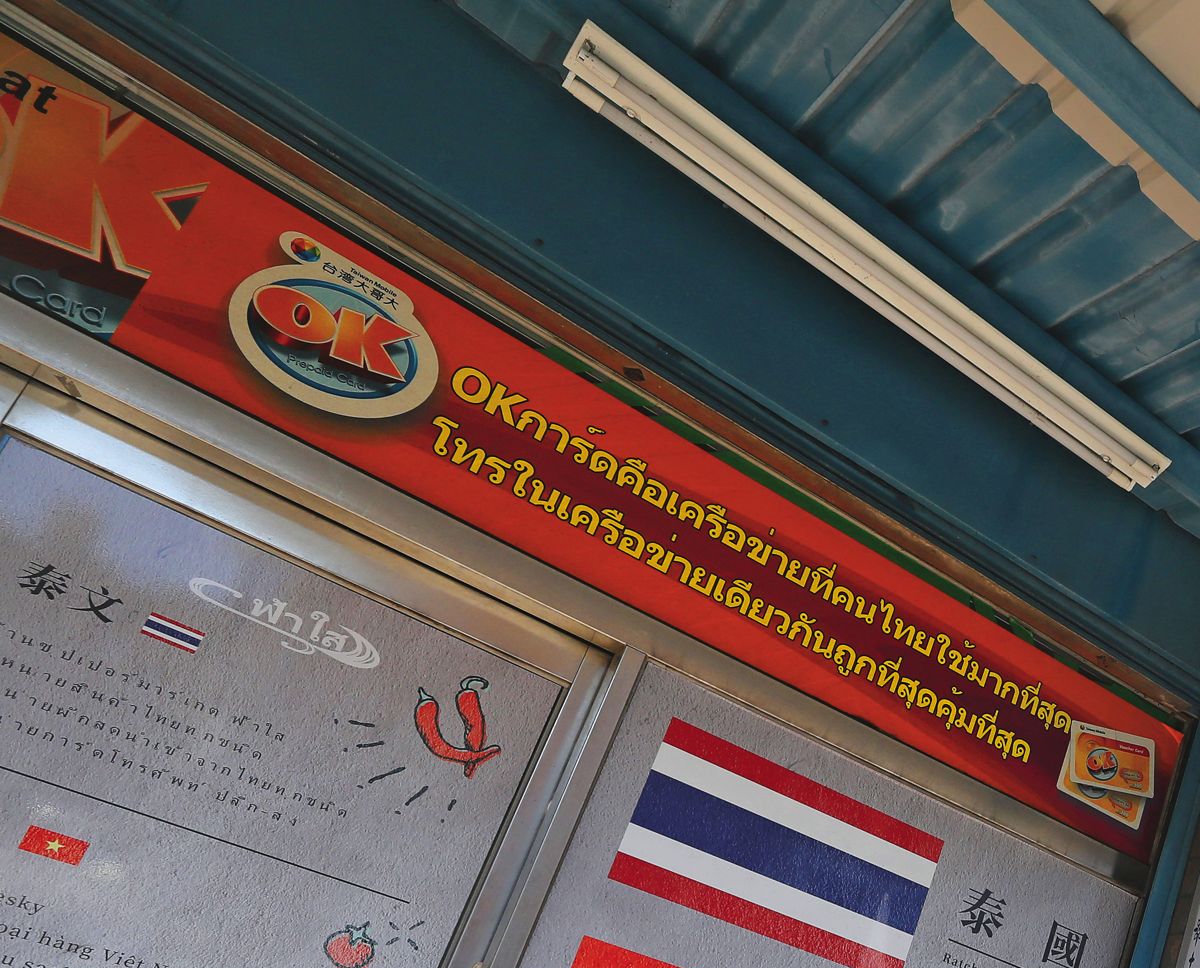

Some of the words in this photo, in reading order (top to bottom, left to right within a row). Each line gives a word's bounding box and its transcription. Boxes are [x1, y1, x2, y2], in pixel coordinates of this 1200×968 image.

[350, 267, 375, 284] Taiwan
[373, 280, 398, 298] Mobile
[10, 274, 108, 328] Card
[252, 284, 420, 383] OK
[336, 369, 366, 392] Card
[17, 562, 123, 623] 泰文
[1087, 751, 1117, 771] OK
[38, 931, 94, 960] hàng
